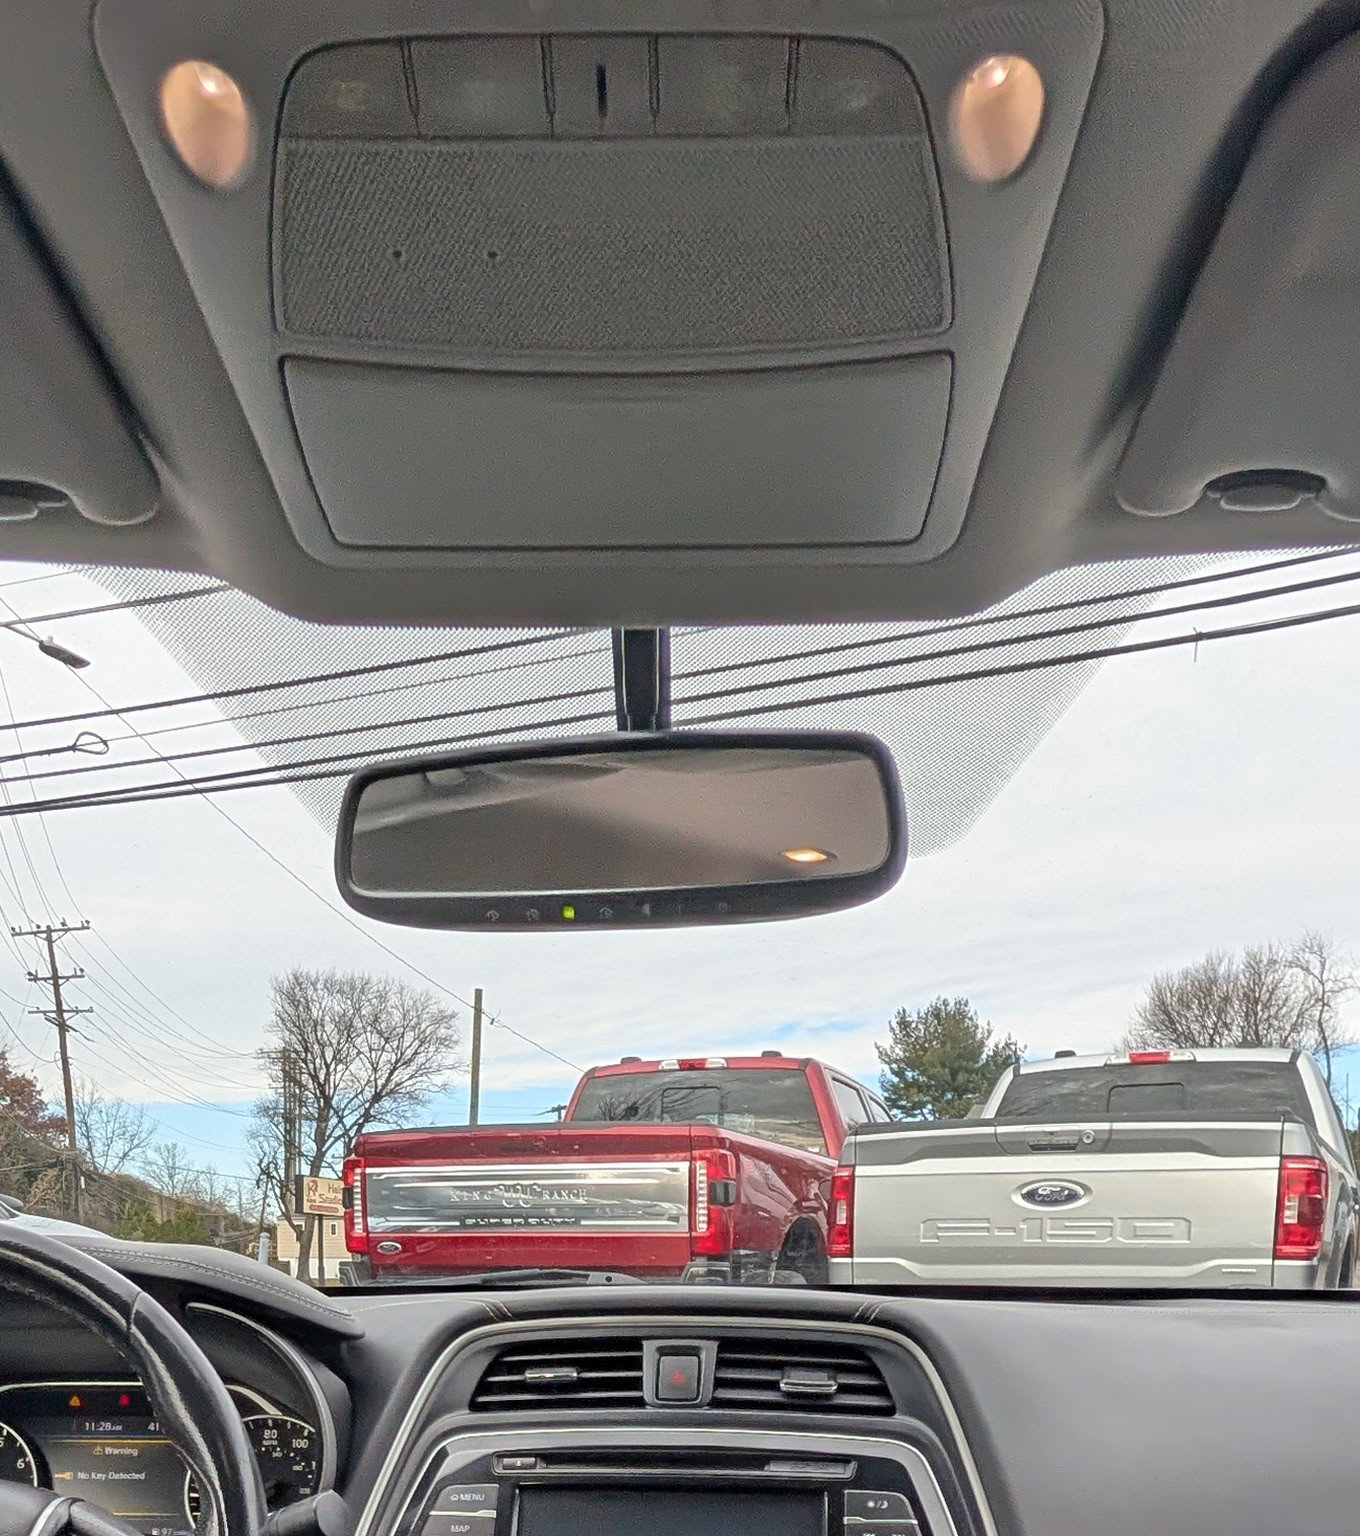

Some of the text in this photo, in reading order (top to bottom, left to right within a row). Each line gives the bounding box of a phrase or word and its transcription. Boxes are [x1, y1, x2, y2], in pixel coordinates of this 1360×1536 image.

[450, 1187, 589, 1202] KING RANCH
[1035, 1186, 1069, 1202] Ford
[920, 1217, 1192, 1244] F-150
[263, 1429, 278, 1439] 80
[292, 1438, 309, 1448] 100
[104, 1446, 139, 1457] Warning
[16, 1459, 25, 1469] 6
[77, 1471, 146, 1481] No Key Detected
[460, 1493, 485, 1501] MENU
[450, 1524, 471, 1533] MAP
